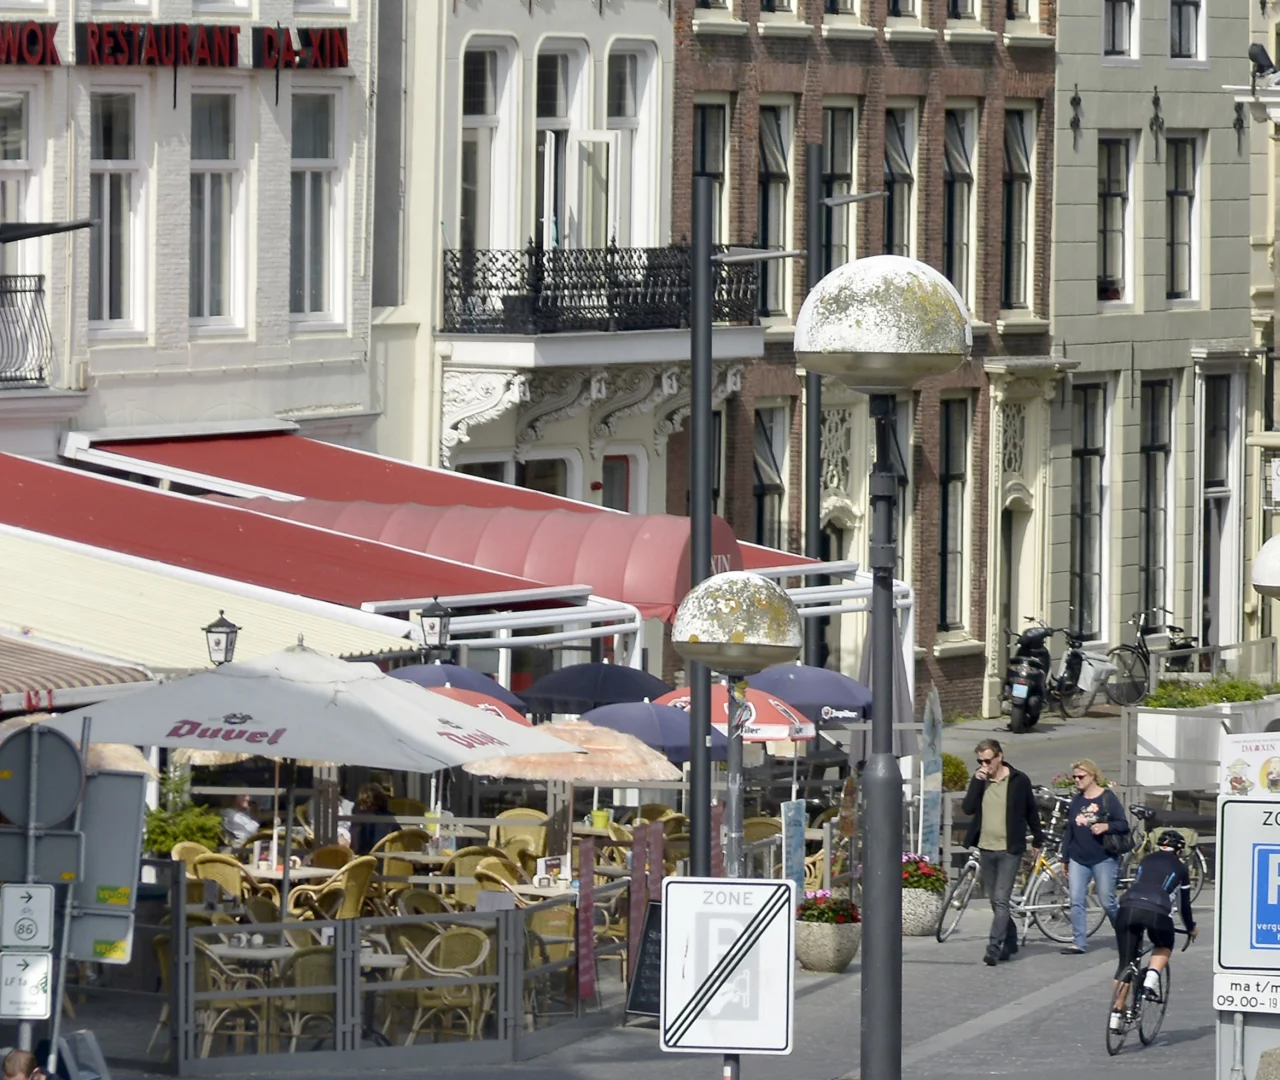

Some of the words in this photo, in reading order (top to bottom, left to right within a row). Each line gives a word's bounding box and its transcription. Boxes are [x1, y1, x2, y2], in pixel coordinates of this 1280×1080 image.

[0, 20, 62, 65] WOK
[86, 22, 241, 67] RESTAURANT
[264, 26, 348, 69] DA-XIN
[165, 719, 287, 746] Duvel
[702, 891, 754, 906] ZONE
[16, 923, 34, 935] 86
[4, 977, 16, 987] LF
[1230, 982, 1250, 992] ma
